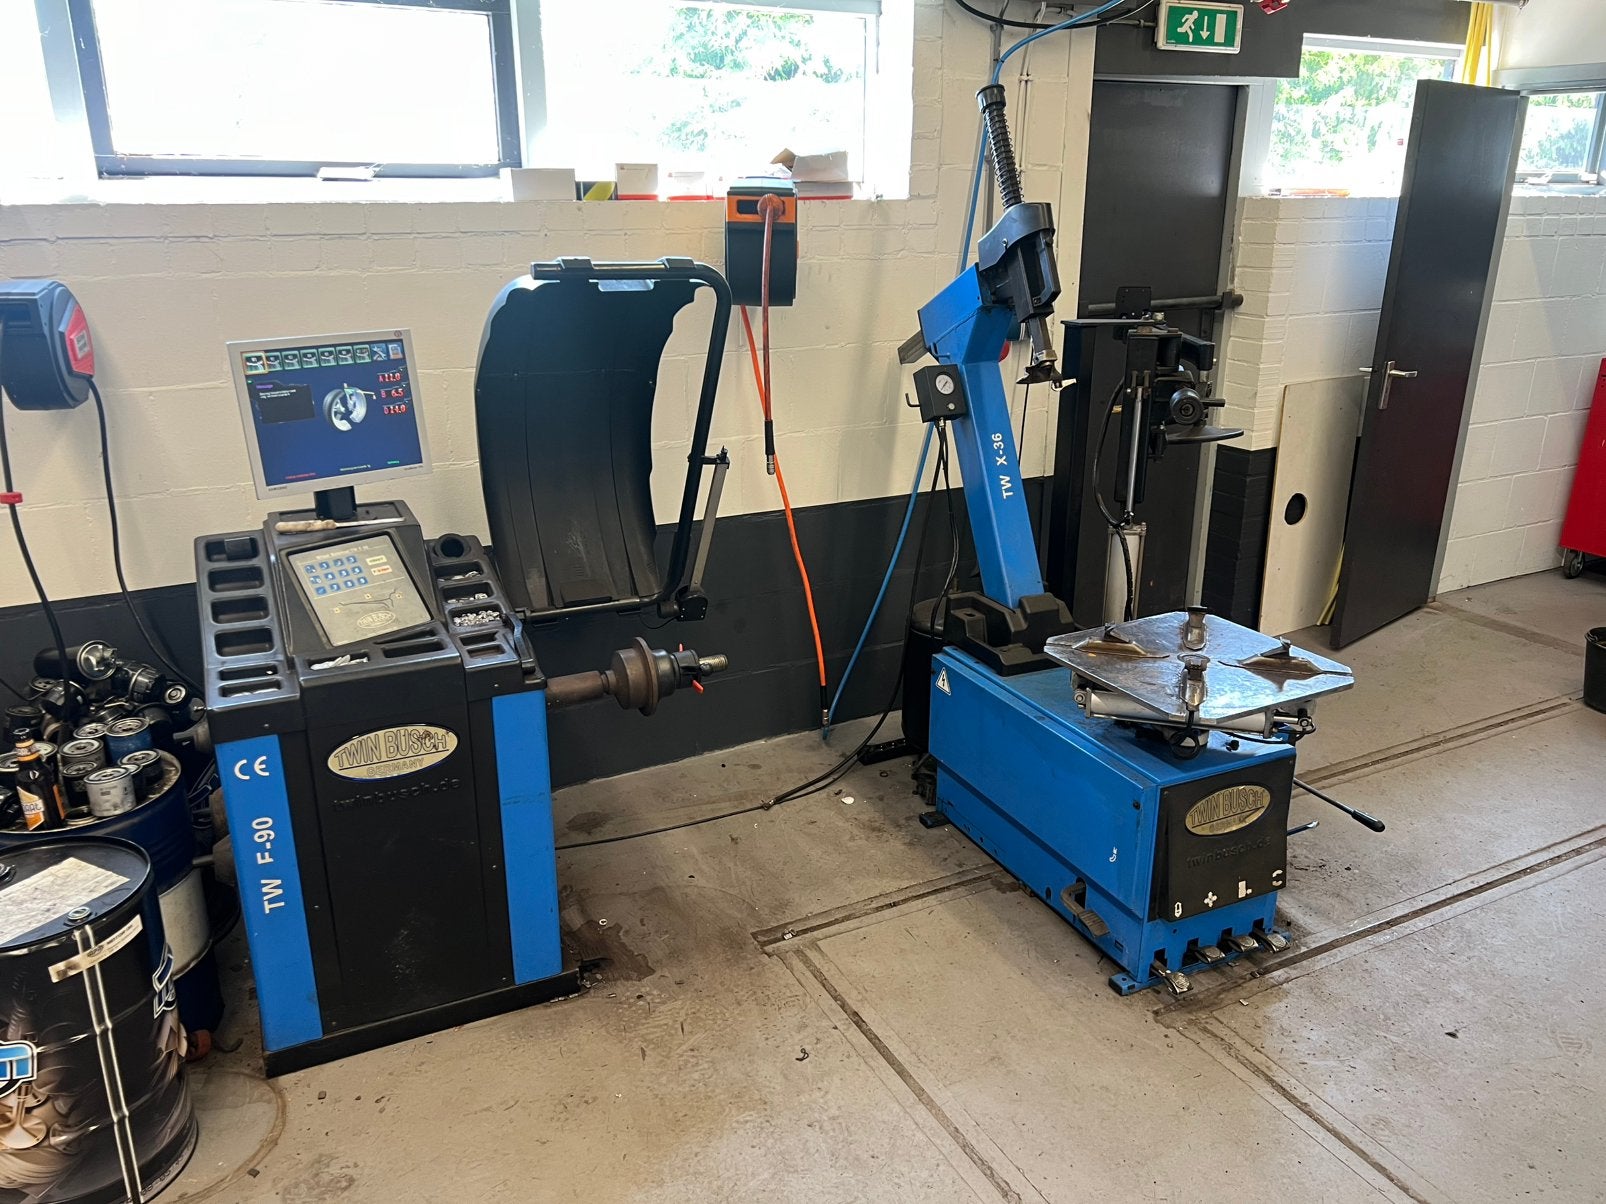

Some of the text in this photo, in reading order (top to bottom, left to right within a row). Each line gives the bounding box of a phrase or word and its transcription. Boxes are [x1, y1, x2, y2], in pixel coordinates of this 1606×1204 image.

[992, 433, 1014, 500] TW X-36
[234, 755, 270, 780] CE
[334, 728, 448, 768] TWIN BUSCH
[366, 757, 425, 777] GERMANY
[1189, 793, 1221, 826] TWIN
[1222, 788, 1265, 815] BUSCH
[251, 816, 285, 914] TW F-90
